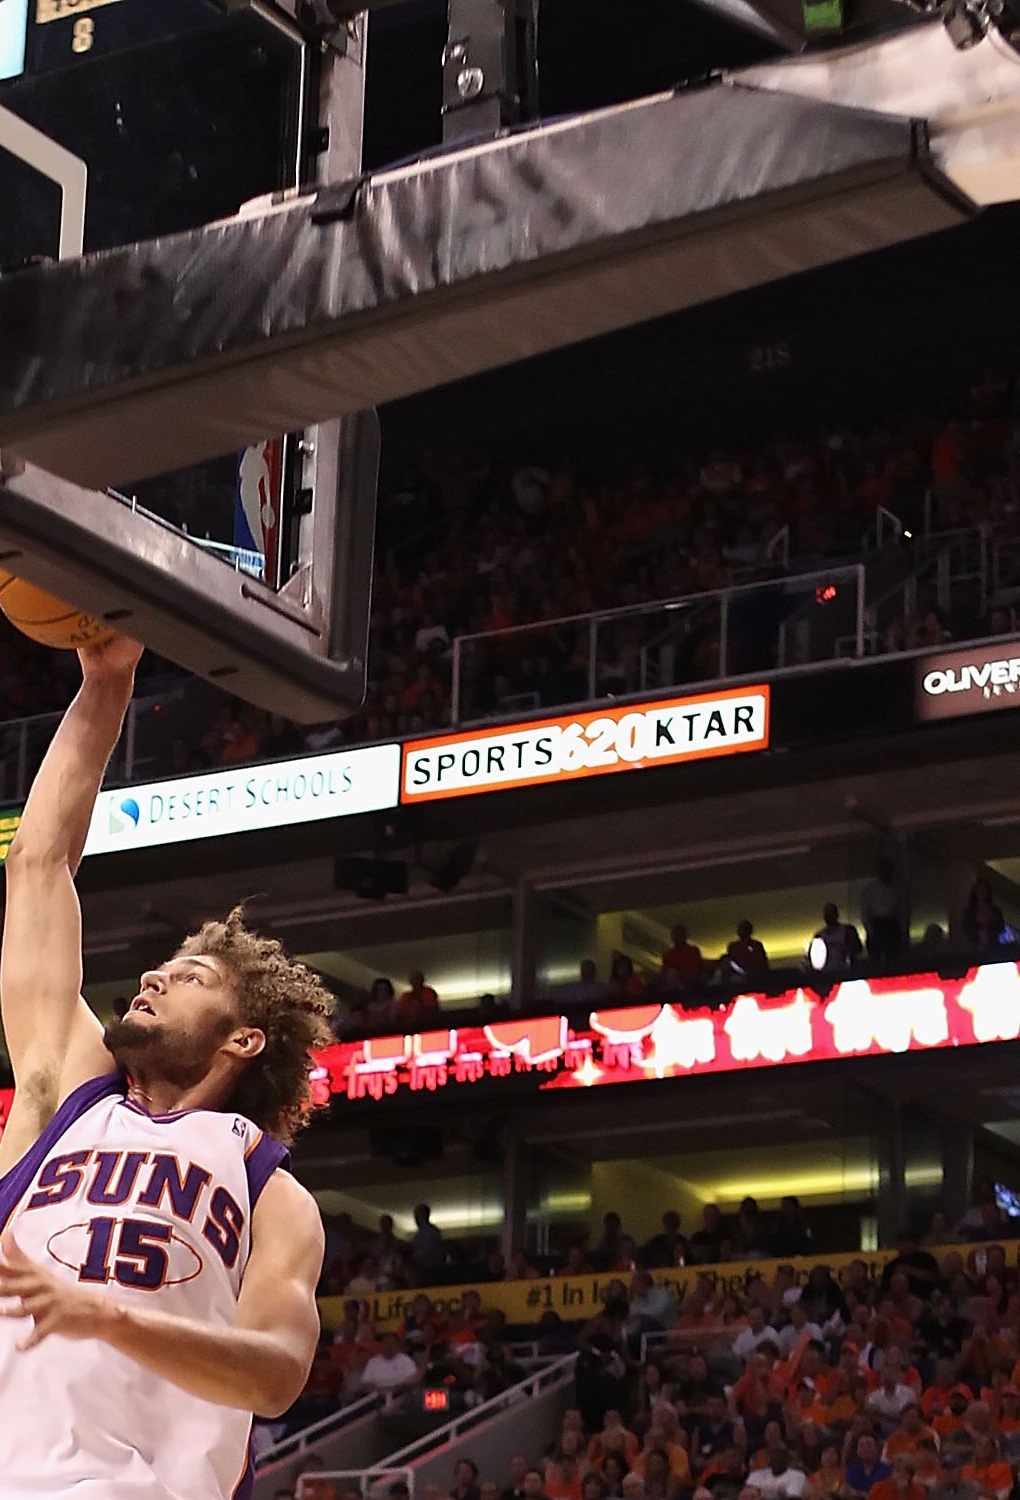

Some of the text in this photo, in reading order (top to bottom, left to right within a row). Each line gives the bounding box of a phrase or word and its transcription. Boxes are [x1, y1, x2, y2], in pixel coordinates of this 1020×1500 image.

[72, 17, 94, 53] 8
[413, 738, 553, 785] SPORTS
[655, 705, 754, 747] KTAR
[150, 766, 353, 824] DESERT SCHOOLS
[26, 1149, 245, 1270] SUNS
[78, 1215, 174, 1292] 15
